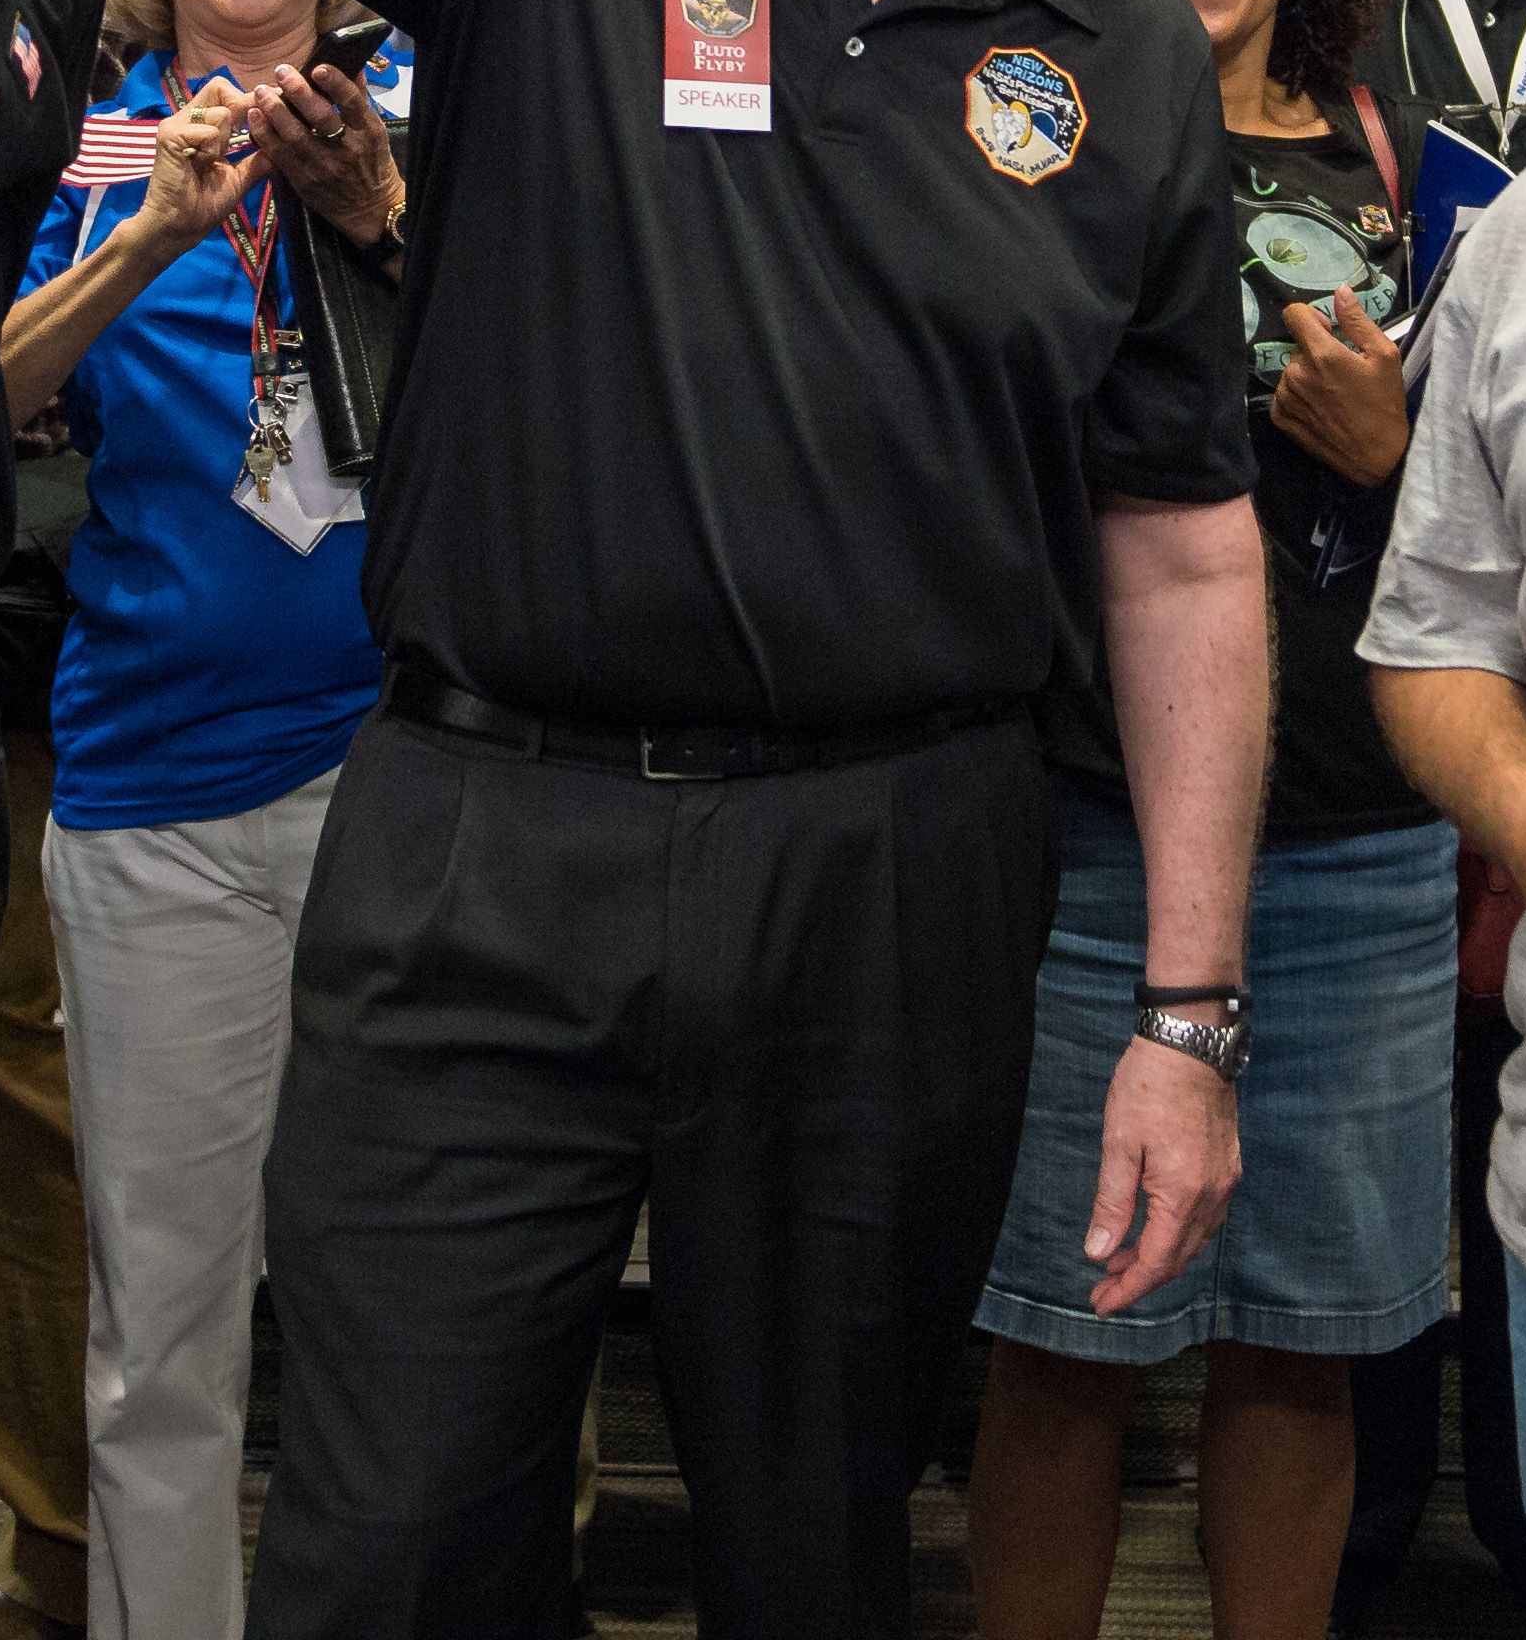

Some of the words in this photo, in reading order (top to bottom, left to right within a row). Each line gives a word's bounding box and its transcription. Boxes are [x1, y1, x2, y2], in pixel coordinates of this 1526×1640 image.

[1012, 54, 1045, 73] NEW
[995, 58, 1064, 93] HORIZONS
[678, 89, 761, 109] SPEAKER
